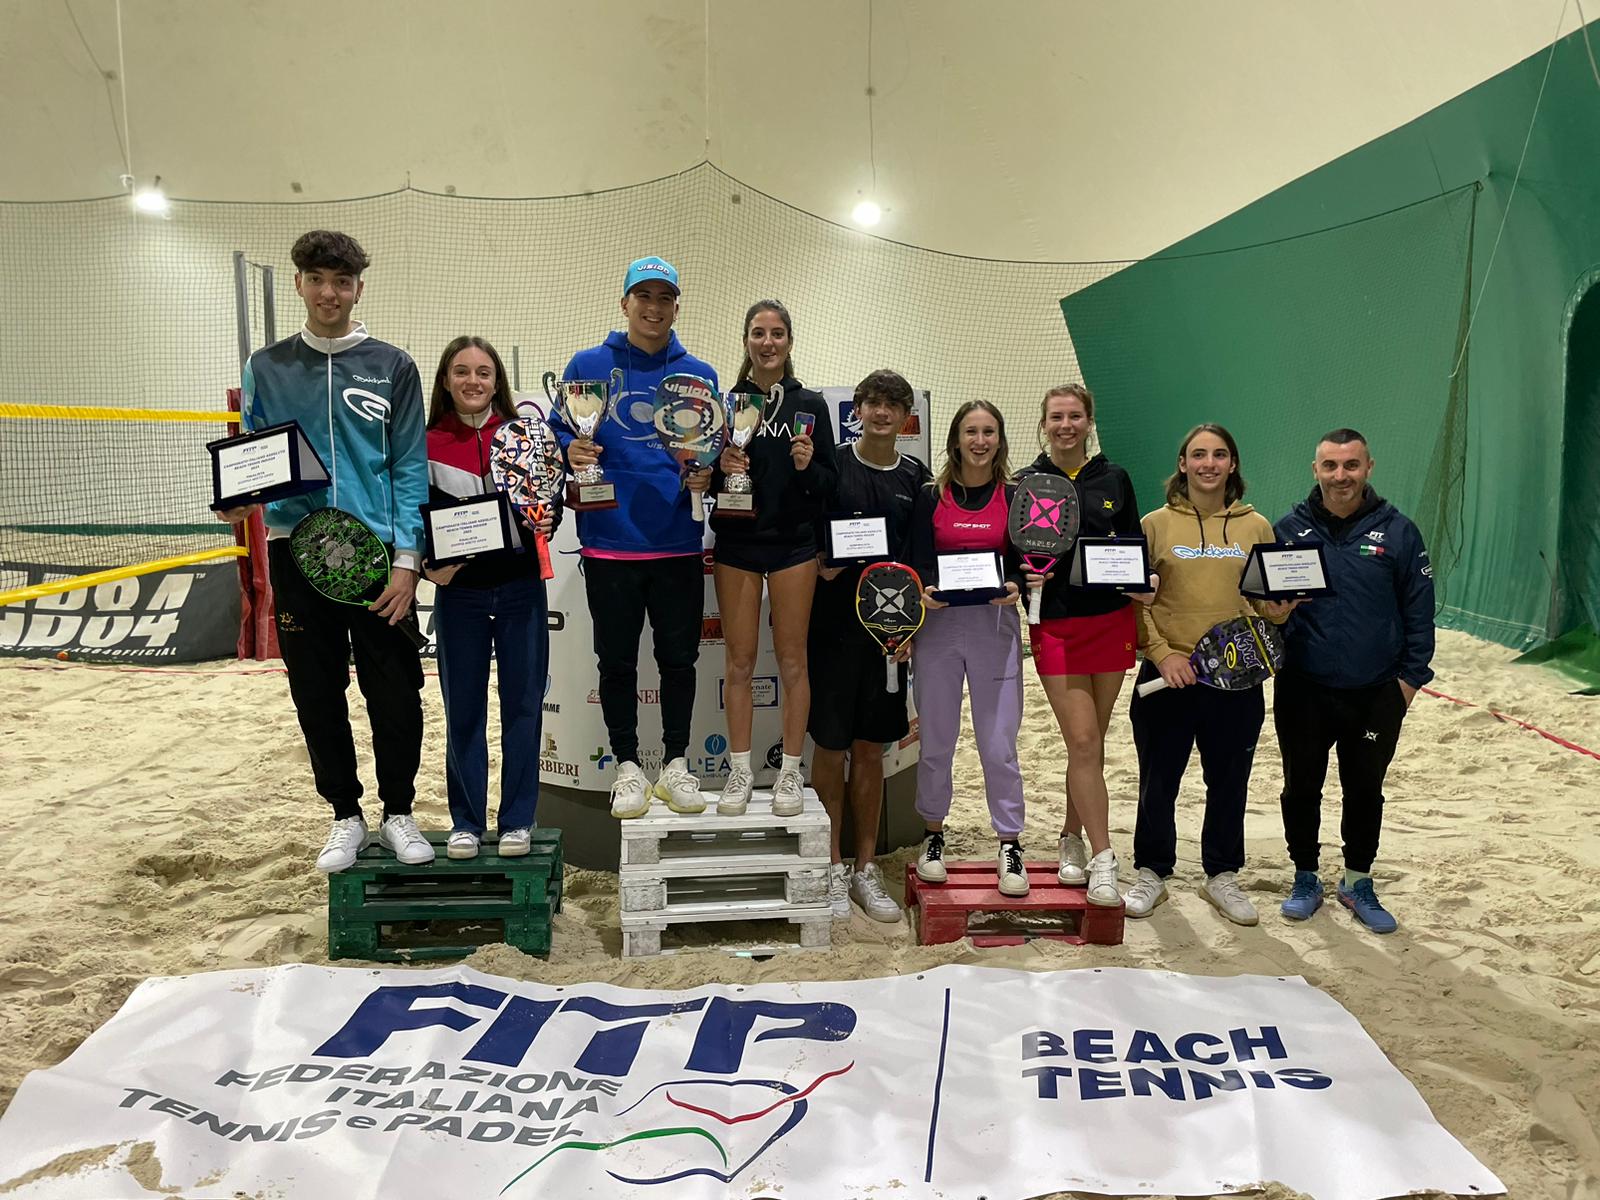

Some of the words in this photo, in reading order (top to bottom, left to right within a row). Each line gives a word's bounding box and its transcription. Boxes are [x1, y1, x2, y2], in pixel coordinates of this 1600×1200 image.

[540, 758, 579, 777] RBIERI
[687, 756, 732, 773] L'EA
[312, 981, 857, 1076] FITP
[1021, 1026, 1288, 1065] BEACH
[214, 1061, 623, 1097] FEDERAZIONE
[1021, 1066, 1332, 1101] TENNIS
[118, 1087, 341, 1143] TENNIS
[346, 1113, 372, 1130] e
[383, 1113, 584, 1147] PADEL
[325, 1086, 600, 1121] ITALIANA
